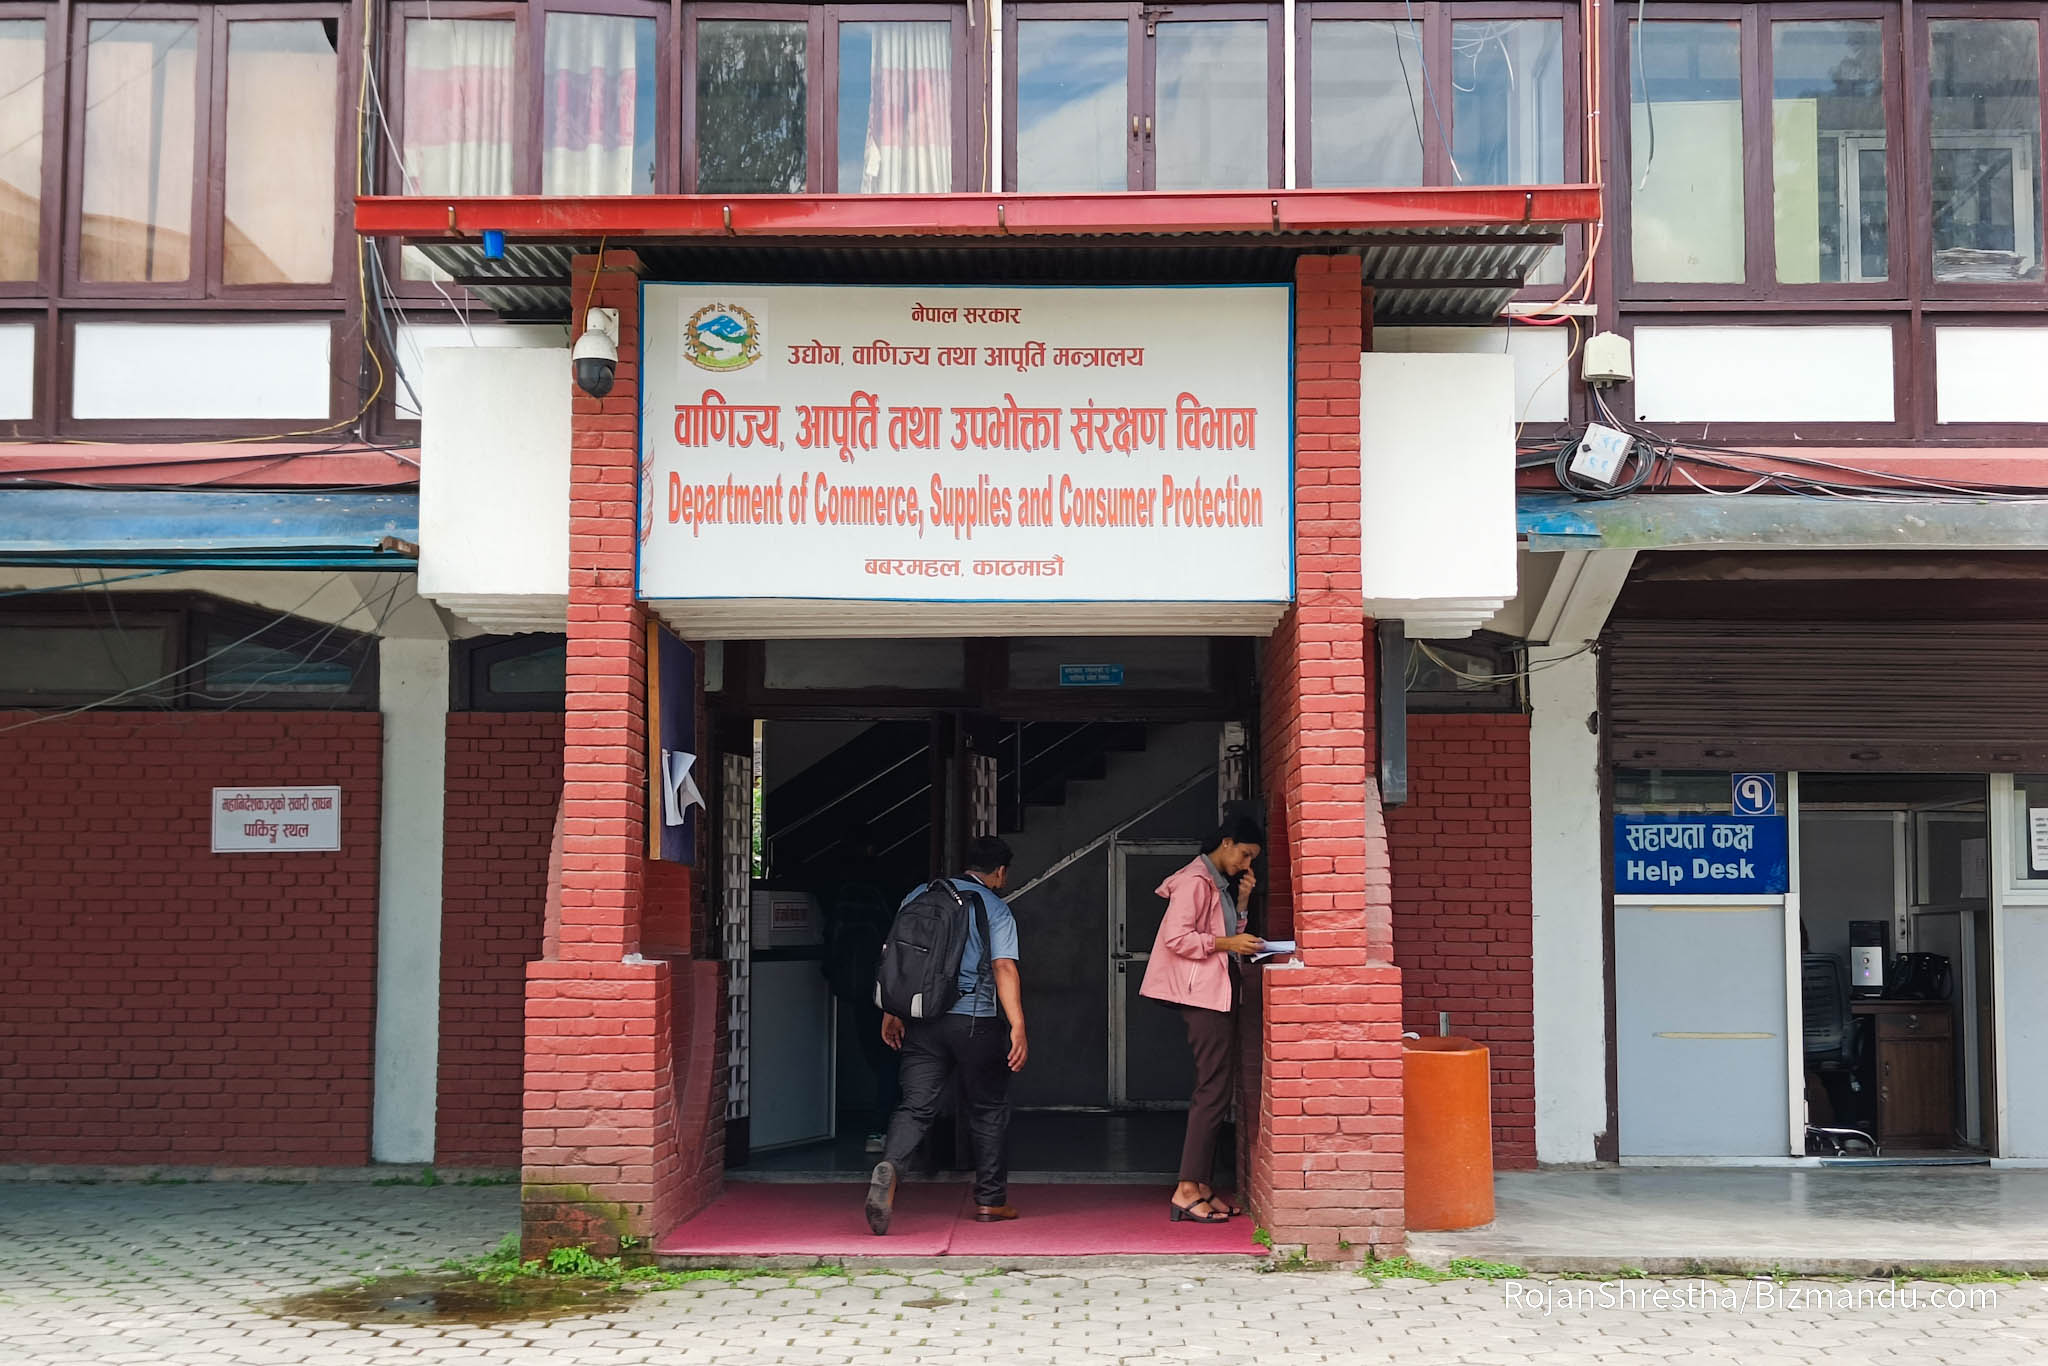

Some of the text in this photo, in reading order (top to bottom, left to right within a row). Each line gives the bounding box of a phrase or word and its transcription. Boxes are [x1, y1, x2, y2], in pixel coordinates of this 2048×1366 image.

[911, 303, 1022, 324] नेपाल सरकार
[788, 338, 1145, 373] उद्योग, वाणिज्य तथा आपूर्ति मन्त्रालय
[674, 388, 1258, 464] वाणिज्य, आपूर्ति तथा उपभोक्ता संरक्षण विभाग
[668, 471, 1263, 540] Department of Commerce, Supplies and Consumer Protection
[864, 558, 964, 578] बबरमहल,
[282, 823, 309, 839] स्थल
[1625, 823, 1755, 853] सहायता कक्ष
[1627, 858, 1755, 887] Help Desk
